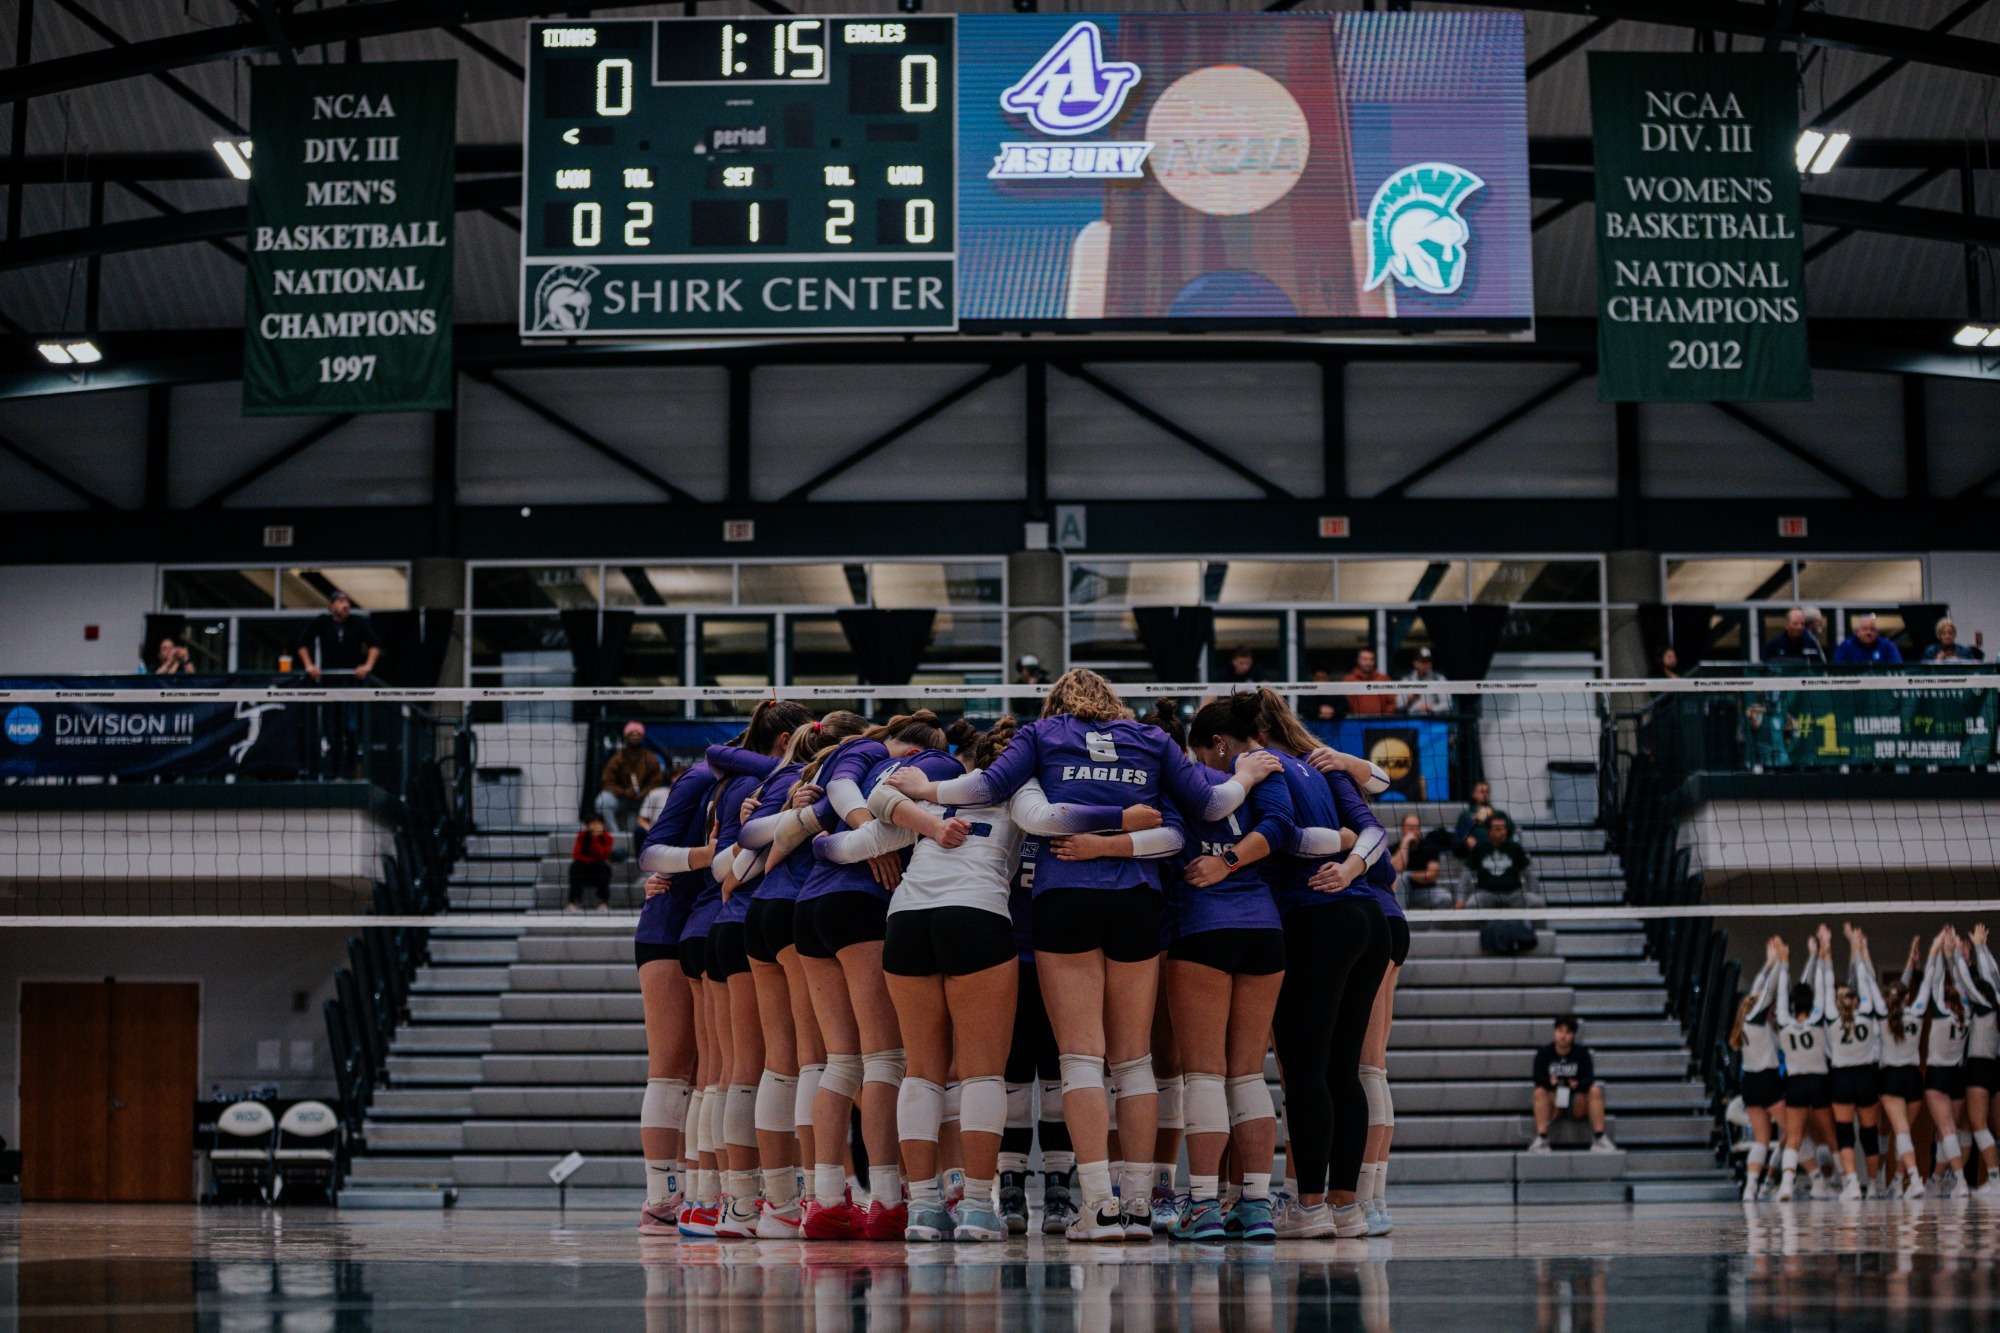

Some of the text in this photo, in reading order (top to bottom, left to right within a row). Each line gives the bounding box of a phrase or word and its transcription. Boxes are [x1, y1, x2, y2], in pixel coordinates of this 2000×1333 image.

[845, 24, 906, 43] EAGLES
[722, 20, 823, 78] 1:15
[596, 58, 632, 116] 0
[900, 54, 937, 112] 0
[312, 94, 396, 120] NCAA
[1644, 91, 1745, 119] NCAA
[303, 135, 400, 163] DIV. III
[713, 126, 766, 149] period
[1641, 123, 1753, 152] DIV. III
[1003, 146, 1140, 175] ASBURY
[556, 169, 590, 188] WON
[623, 168, 654, 188] TOL
[723, 167, 754, 186] SET
[824, 166, 855, 186] TOL
[887, 165, 923, 185] WON
[305, 179, 397, 206] MEN'S
[1625, 176, 1773, 204] WOMEN'S
[573, 202, 600, 246] 0
[624, 201, 653, 246] 2
[749, 202, 759, 242] 1
[825, 199, 855, 244] 2
[905, 199, 934, 243] 0
[1605, 212, 1795, 239] BASKETBALL
[254, 221, 446, 251] BASKETBALL
[273, 266, 425, 295] NATIONAL
[1615, 260, 1789, 289] NATIONAL
[603, 276, 946, 314] SHIRK CENTER
[1607, 296, 1800, 323] CHAMPIONS
[260, 309, 437, 339] CHAMPIONS
[319, 355, 377, 383] 1997
[1667, 340, 1743, 370] 2012
[1061, 512, 1083, 542] A
[8, 723, 39, 737] NCAA
[55, 712, 194, 736] DIVISION III
[1062, 766, 1148, 785] EAGLES
[1789, 1032, 1814, 1051] 10
[1840, 1023, 1869, 1045] 20
